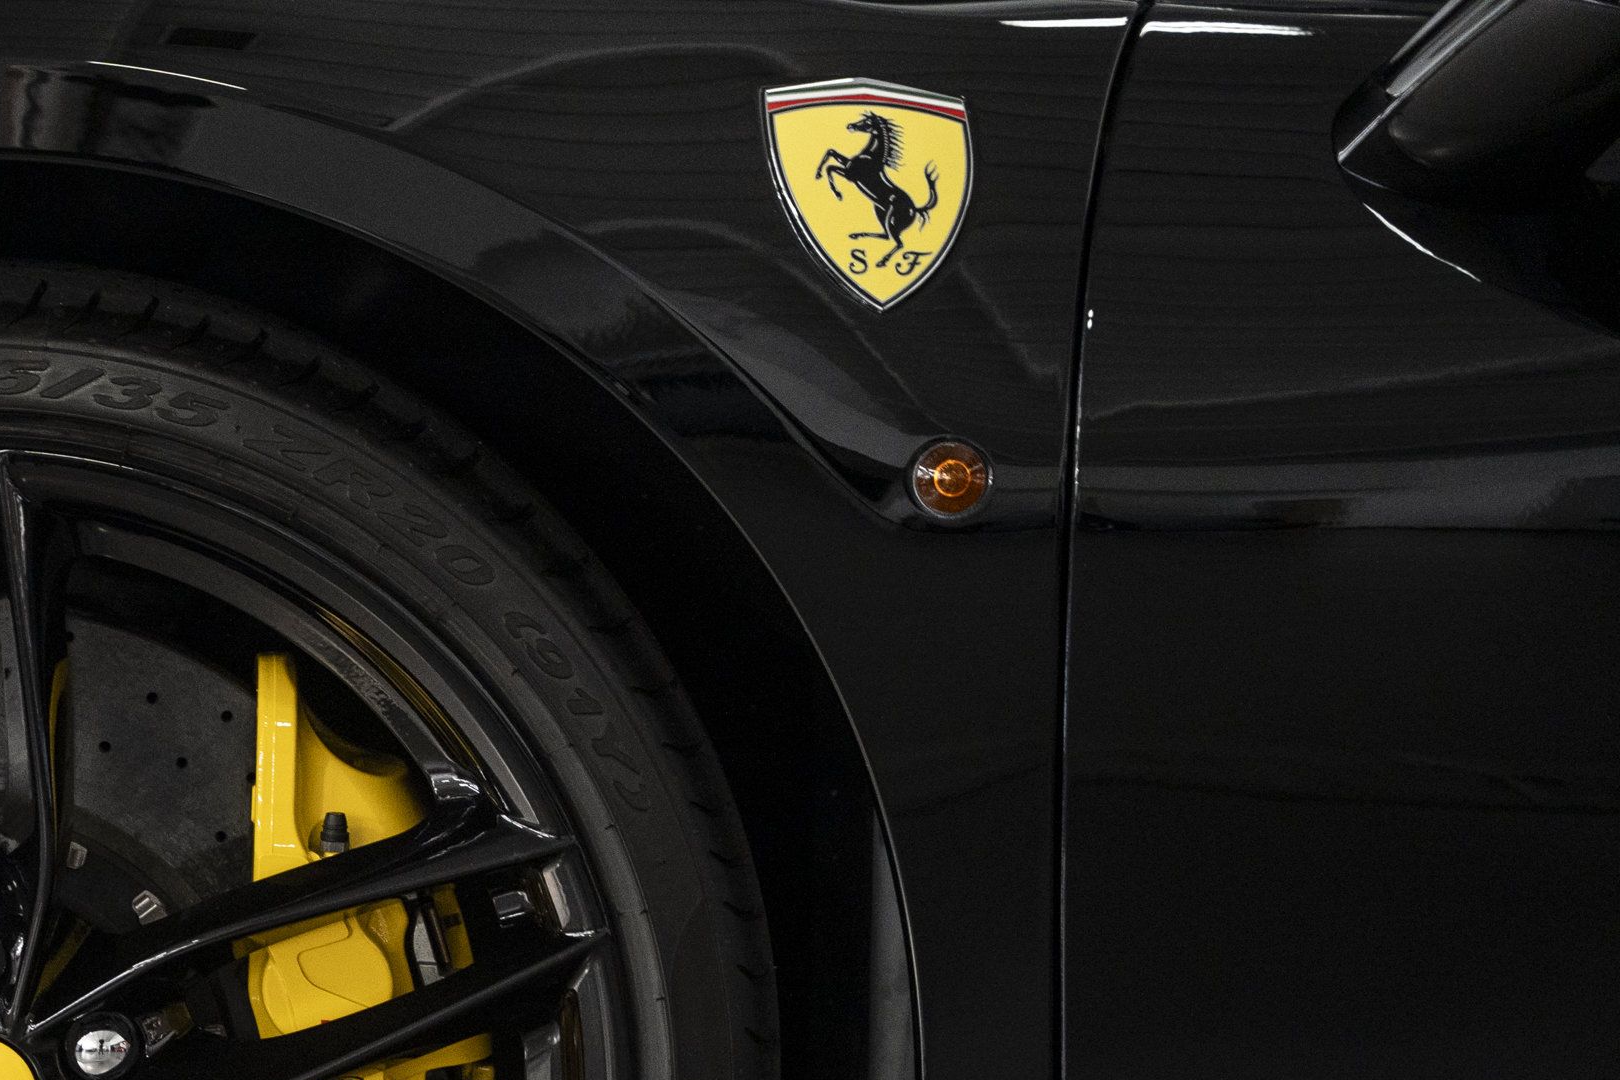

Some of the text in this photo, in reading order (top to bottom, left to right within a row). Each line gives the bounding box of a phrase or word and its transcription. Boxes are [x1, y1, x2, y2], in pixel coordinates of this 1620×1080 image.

[849, 250, 932, 275] S F
[244, 424, 497, 586] ZR20
